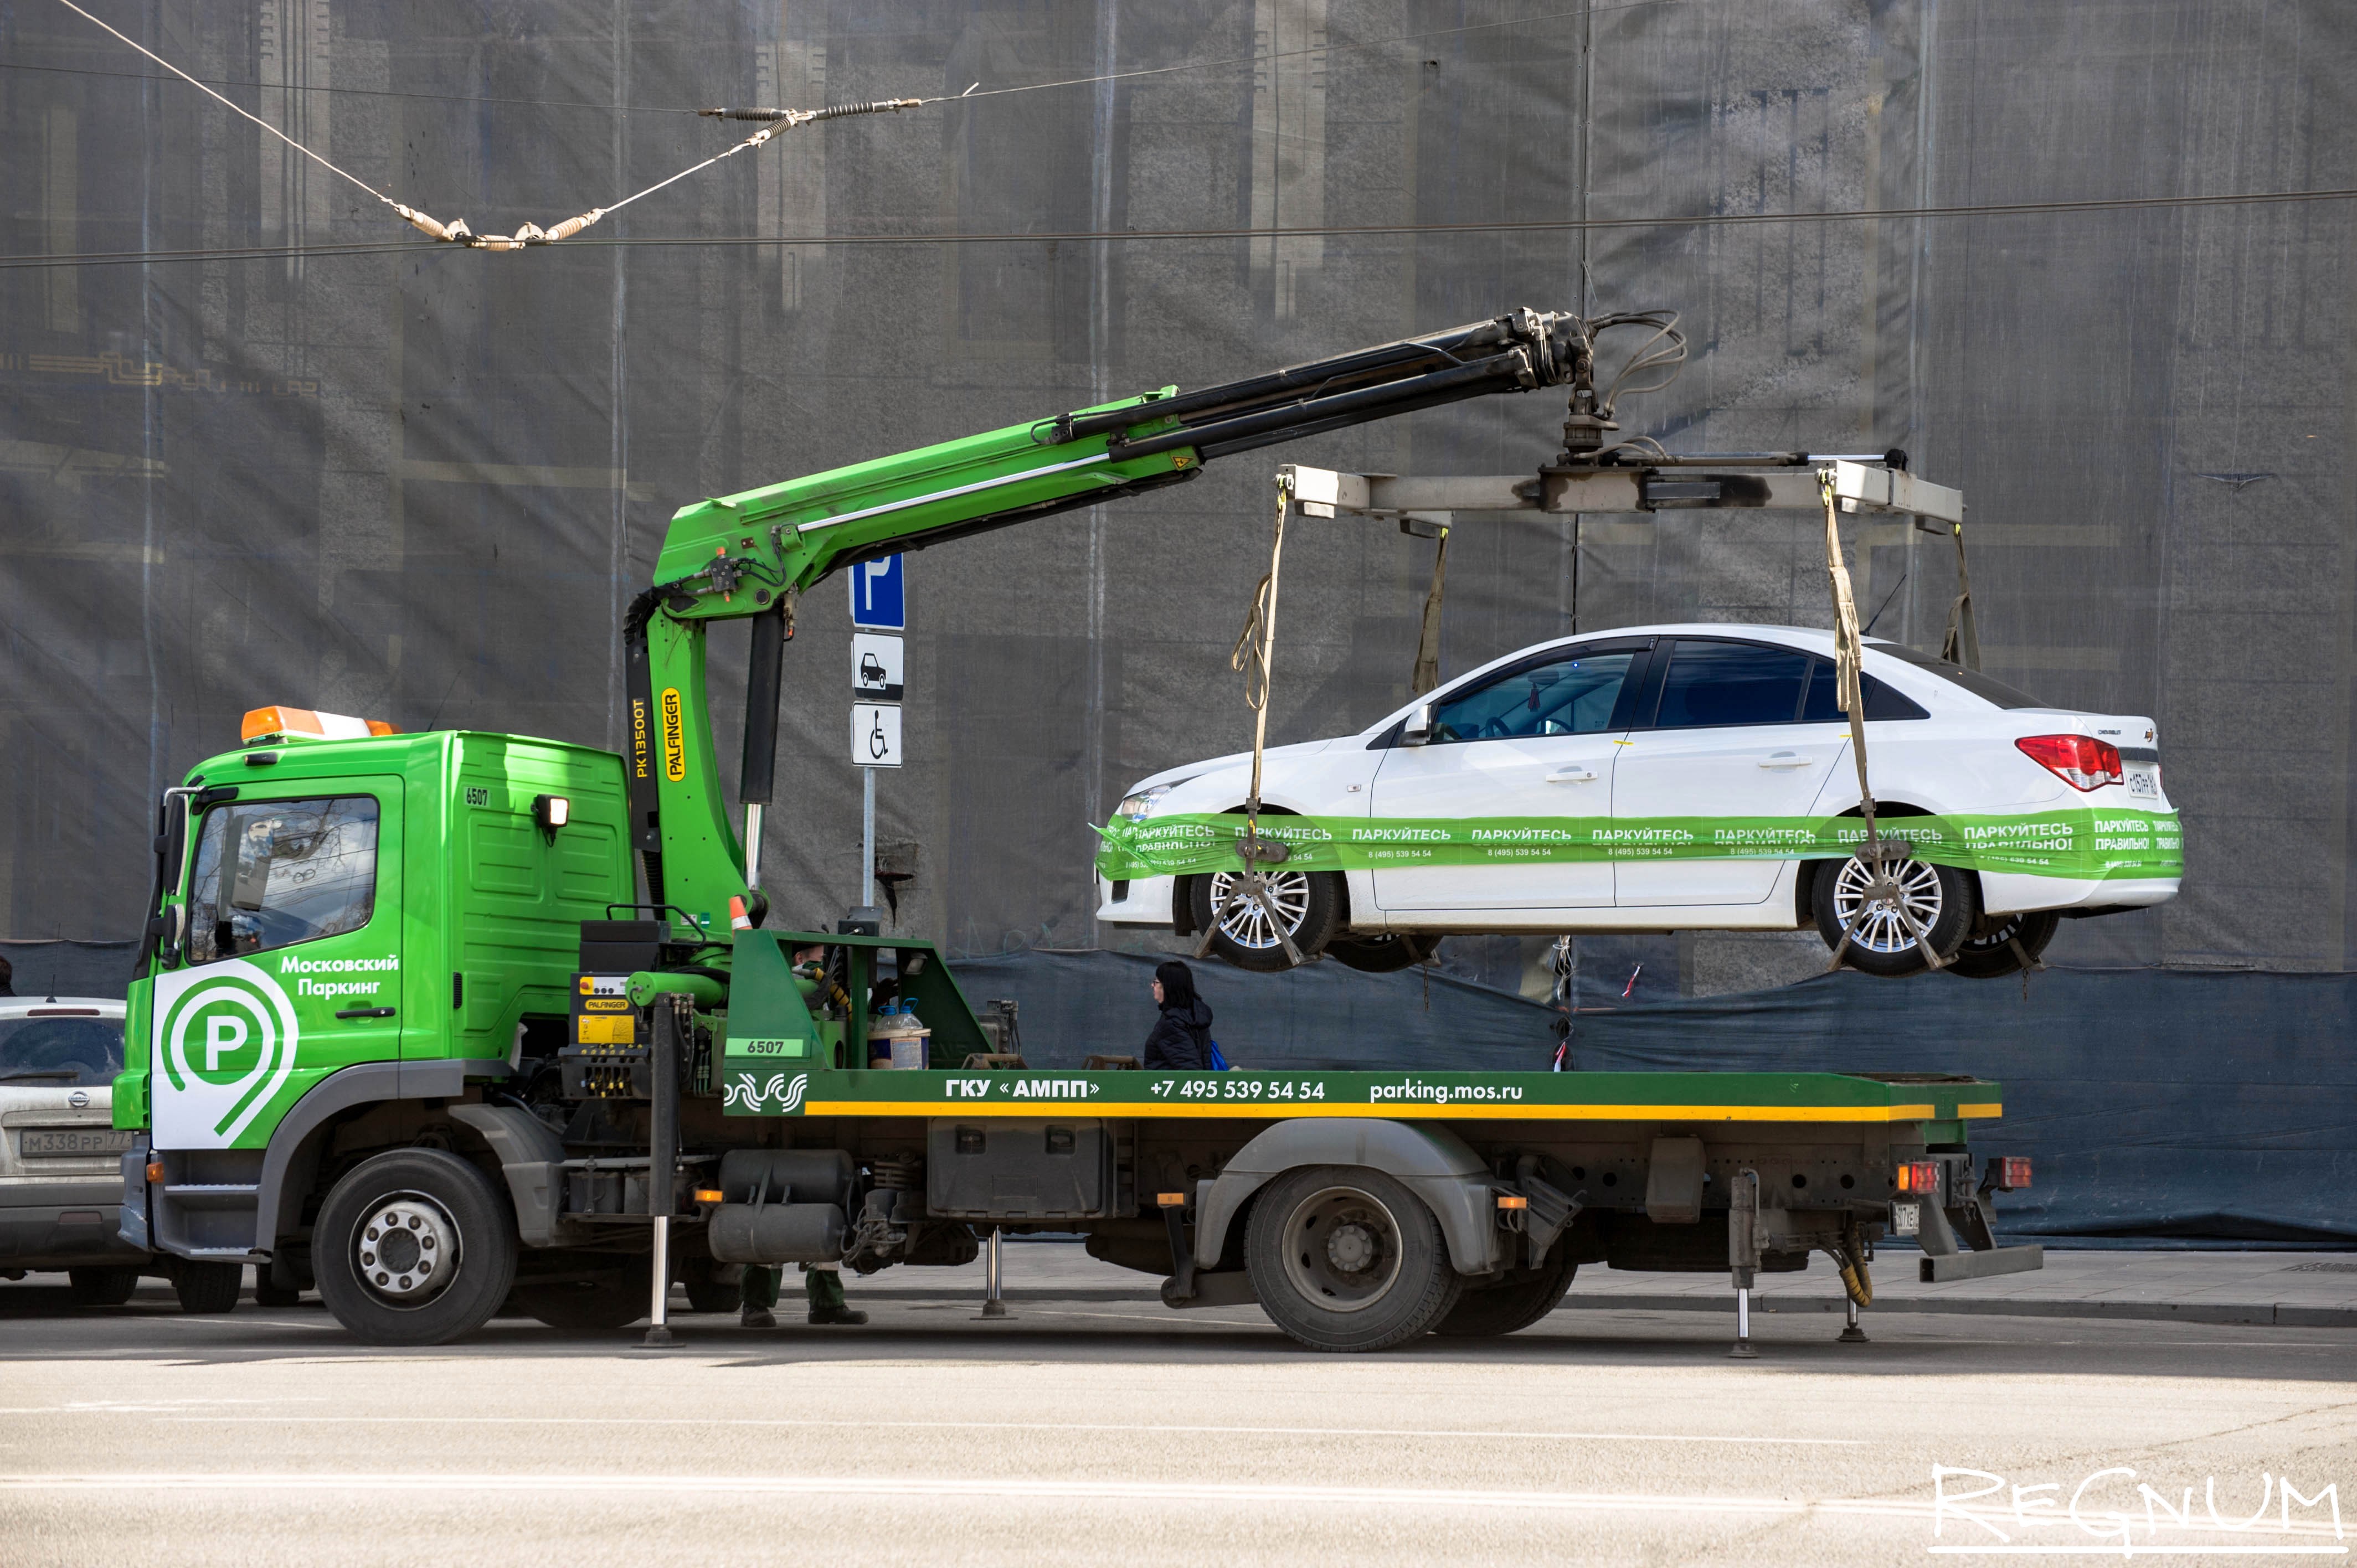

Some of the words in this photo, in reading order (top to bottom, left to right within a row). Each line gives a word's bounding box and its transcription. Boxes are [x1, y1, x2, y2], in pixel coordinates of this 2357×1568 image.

[665, 694, 682, 775] PALFINGER
[467, 788, 487, 806] 6507
[1964, 823, 2073, 839] ПАРКУЙТЕСЬ
[2094, 818, 2149, 832] ПАРКУЙТЕСЬ
[1235, 826, 1332, 840] ПРКУЙТЕСЬ
[1352, 827, 1451, 840] ПАРКУЙТЕСЬ
[1471, 827, 1572, 840] ПАРКУЙТЕСЬ
[1592, 827, 1694, 840] ПАРКУЙТЕСЬ
[1838, 827, 1942, 840] ПАРУЙТЕСЬ
[2095, 838, 2149, 850] ПРАВИЛЬНО!
[1375, 851, 1394, 859] (495)
[1615, 848, 1634, 857] (495)
[281, 954, 399, 973] Московский
[298, 978, 380, 1000] Паркинг
[206, 1015, 248, 1070] P
[748, 1041, 784, 1054] 6507
[946, 1080, 991, 1097] ГКУ
[1151, 1080, 1175, 1097] +7
[1180, 1080, 1218, 1098] 495
[1224, 1081, 1262, 1098] 539
[1268, 1081, 1294, 1099] 54
[1299, 1082, 1325, 1099] 54
[1370, 1079, 1522, 1103] parking.mos.ru
